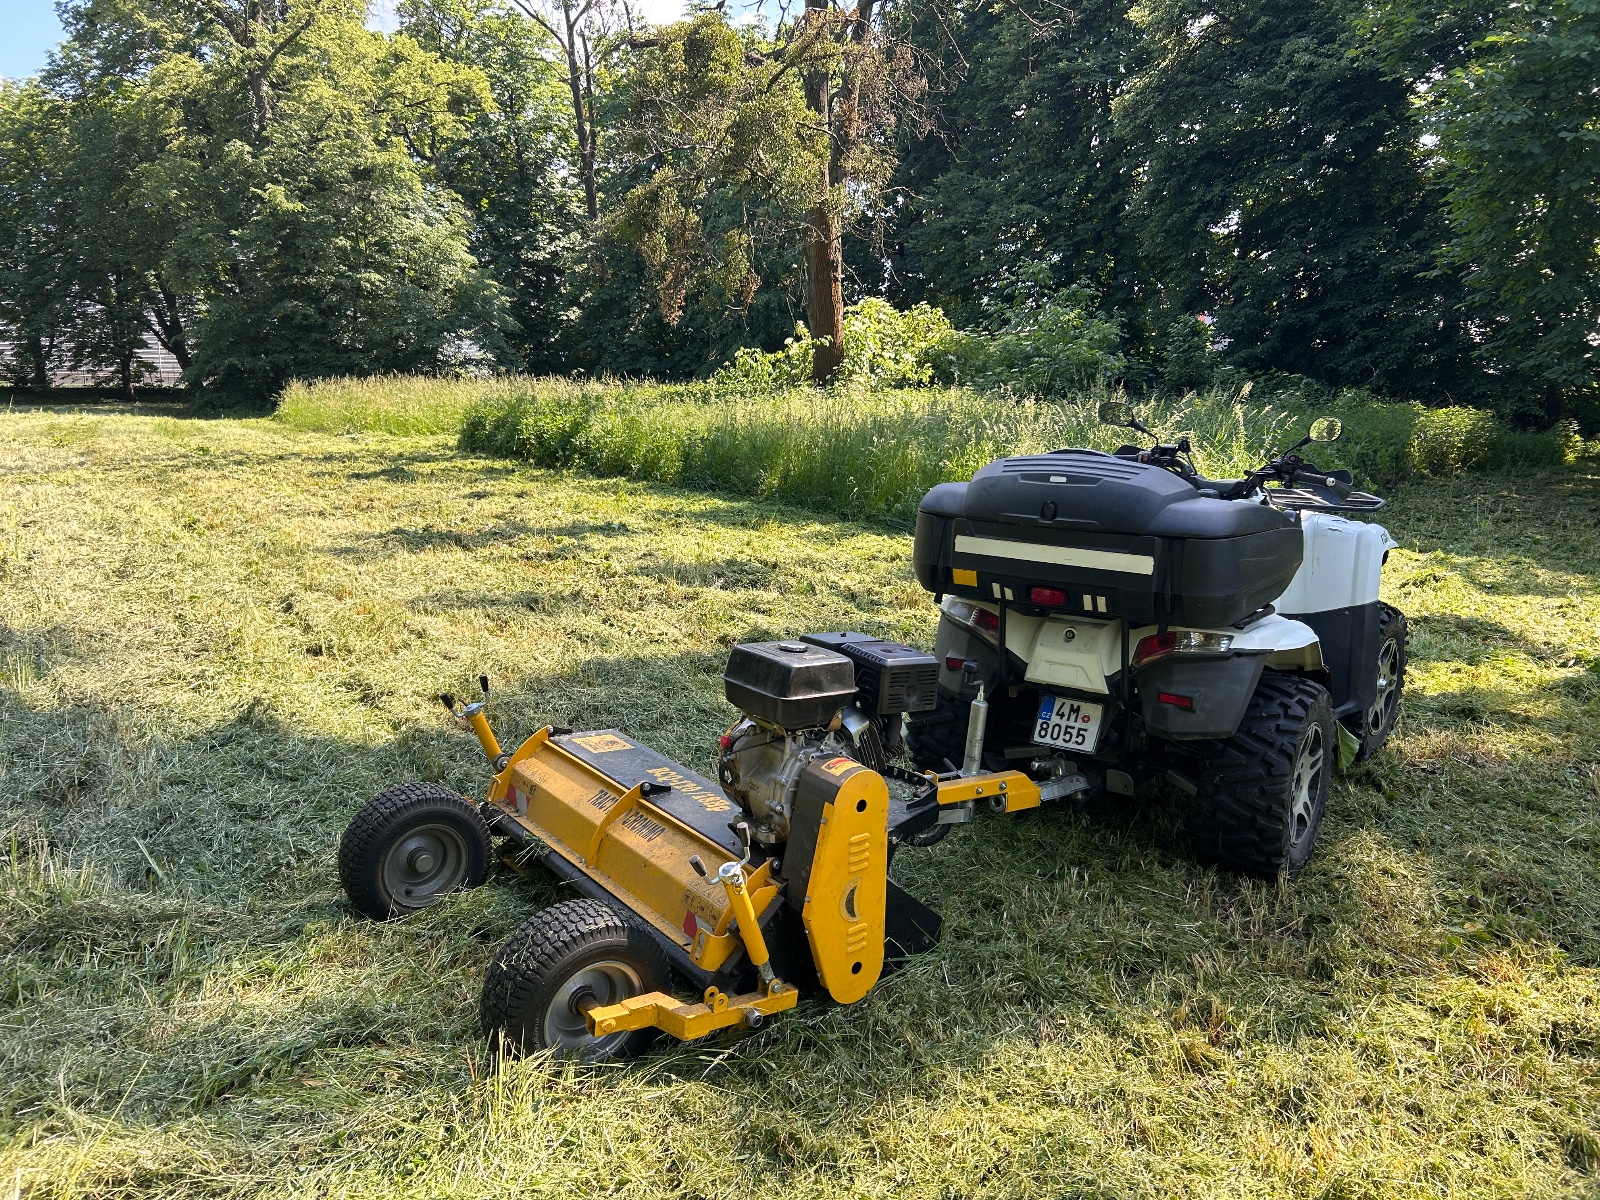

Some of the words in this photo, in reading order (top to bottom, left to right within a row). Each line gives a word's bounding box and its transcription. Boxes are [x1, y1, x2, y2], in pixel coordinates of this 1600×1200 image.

[1041, 711, 1051, 719] CZ
[1055, 702, 1081, 723] 4M
[1037, 720, 1088, 746] 8055
